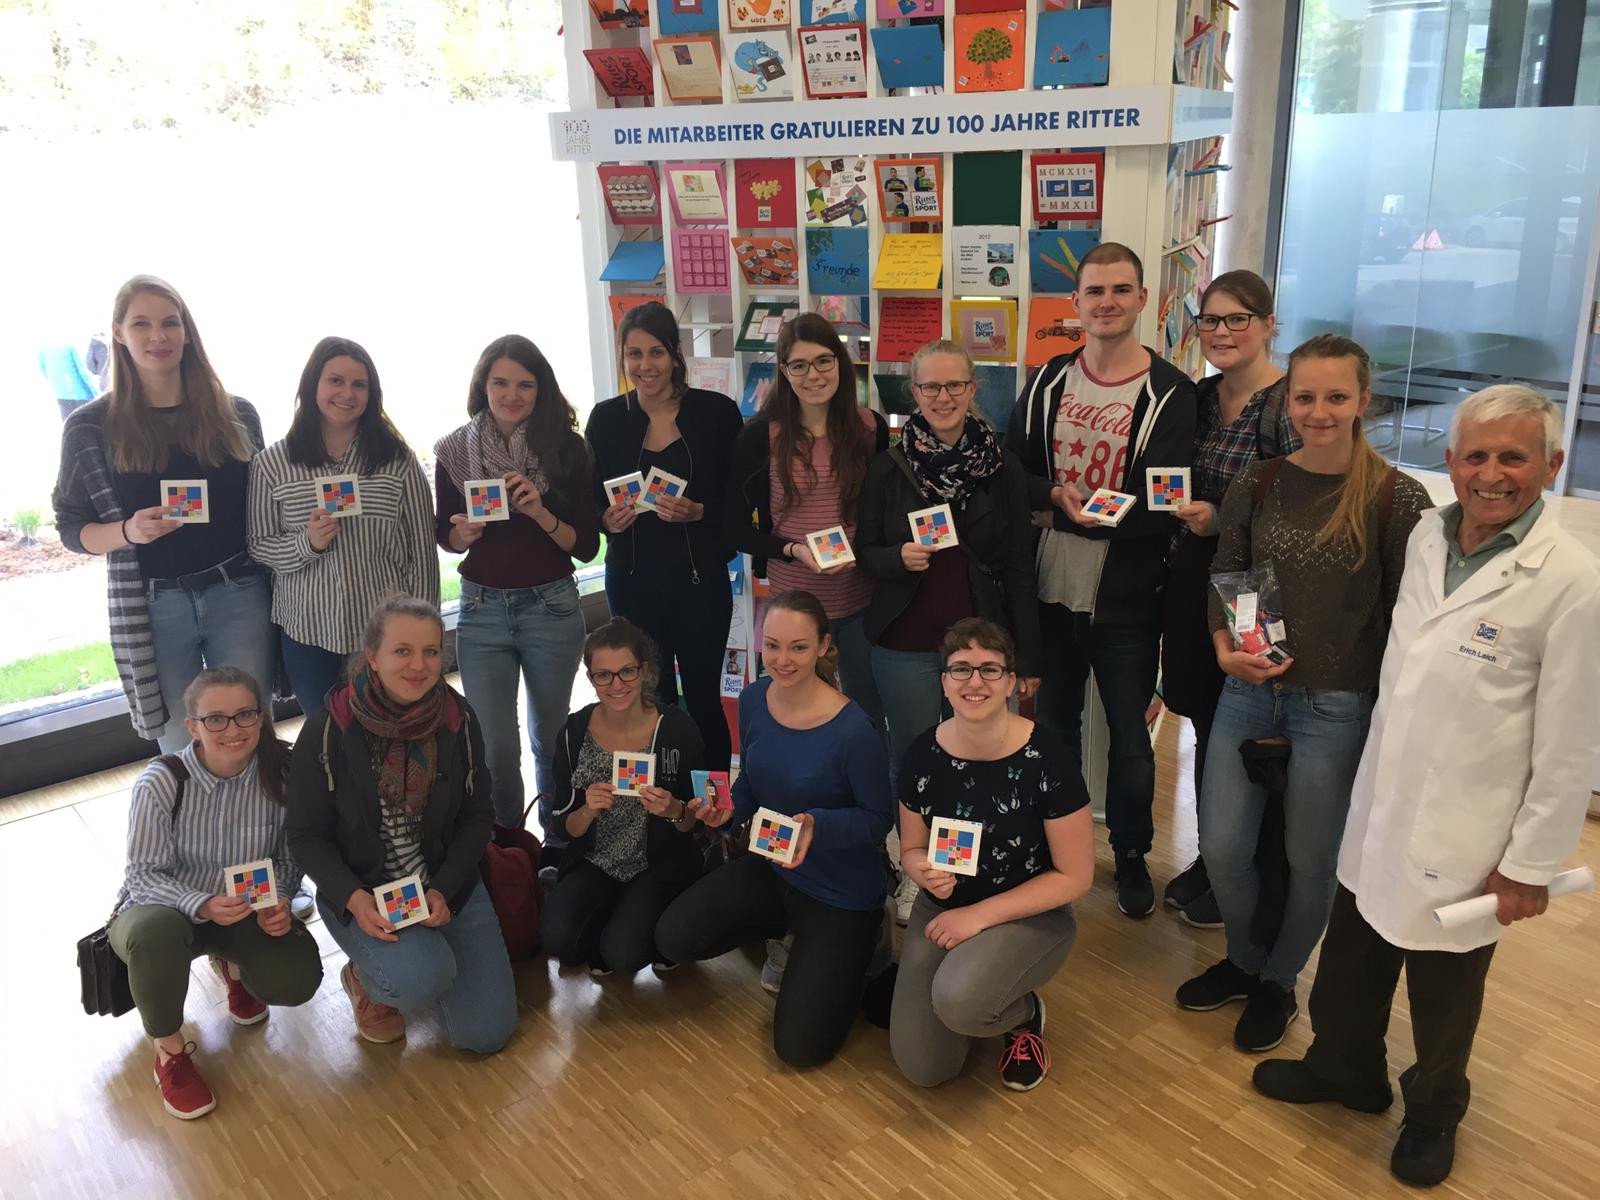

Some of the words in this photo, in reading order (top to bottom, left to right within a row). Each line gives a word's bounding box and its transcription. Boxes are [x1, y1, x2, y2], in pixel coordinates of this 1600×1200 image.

[614, 127, 642, 145] DIE
[648, 123, 764, 144] MITARBEITER
[770, 118, 905, 141] GRATULIEREN
[912, 117, 940, 135] ZU
[948, 115, 984, 134] 100
[991, 111, 1059, 132] JAHRE
[1067, 107, 1140, 129] RITTER
[566, 135, 591, 145] JAHRE
[566, 144, 591, 155] RITTER
[812, 258, 860, 283] Freunde
[1459, 645, 1476, 656] Erich
